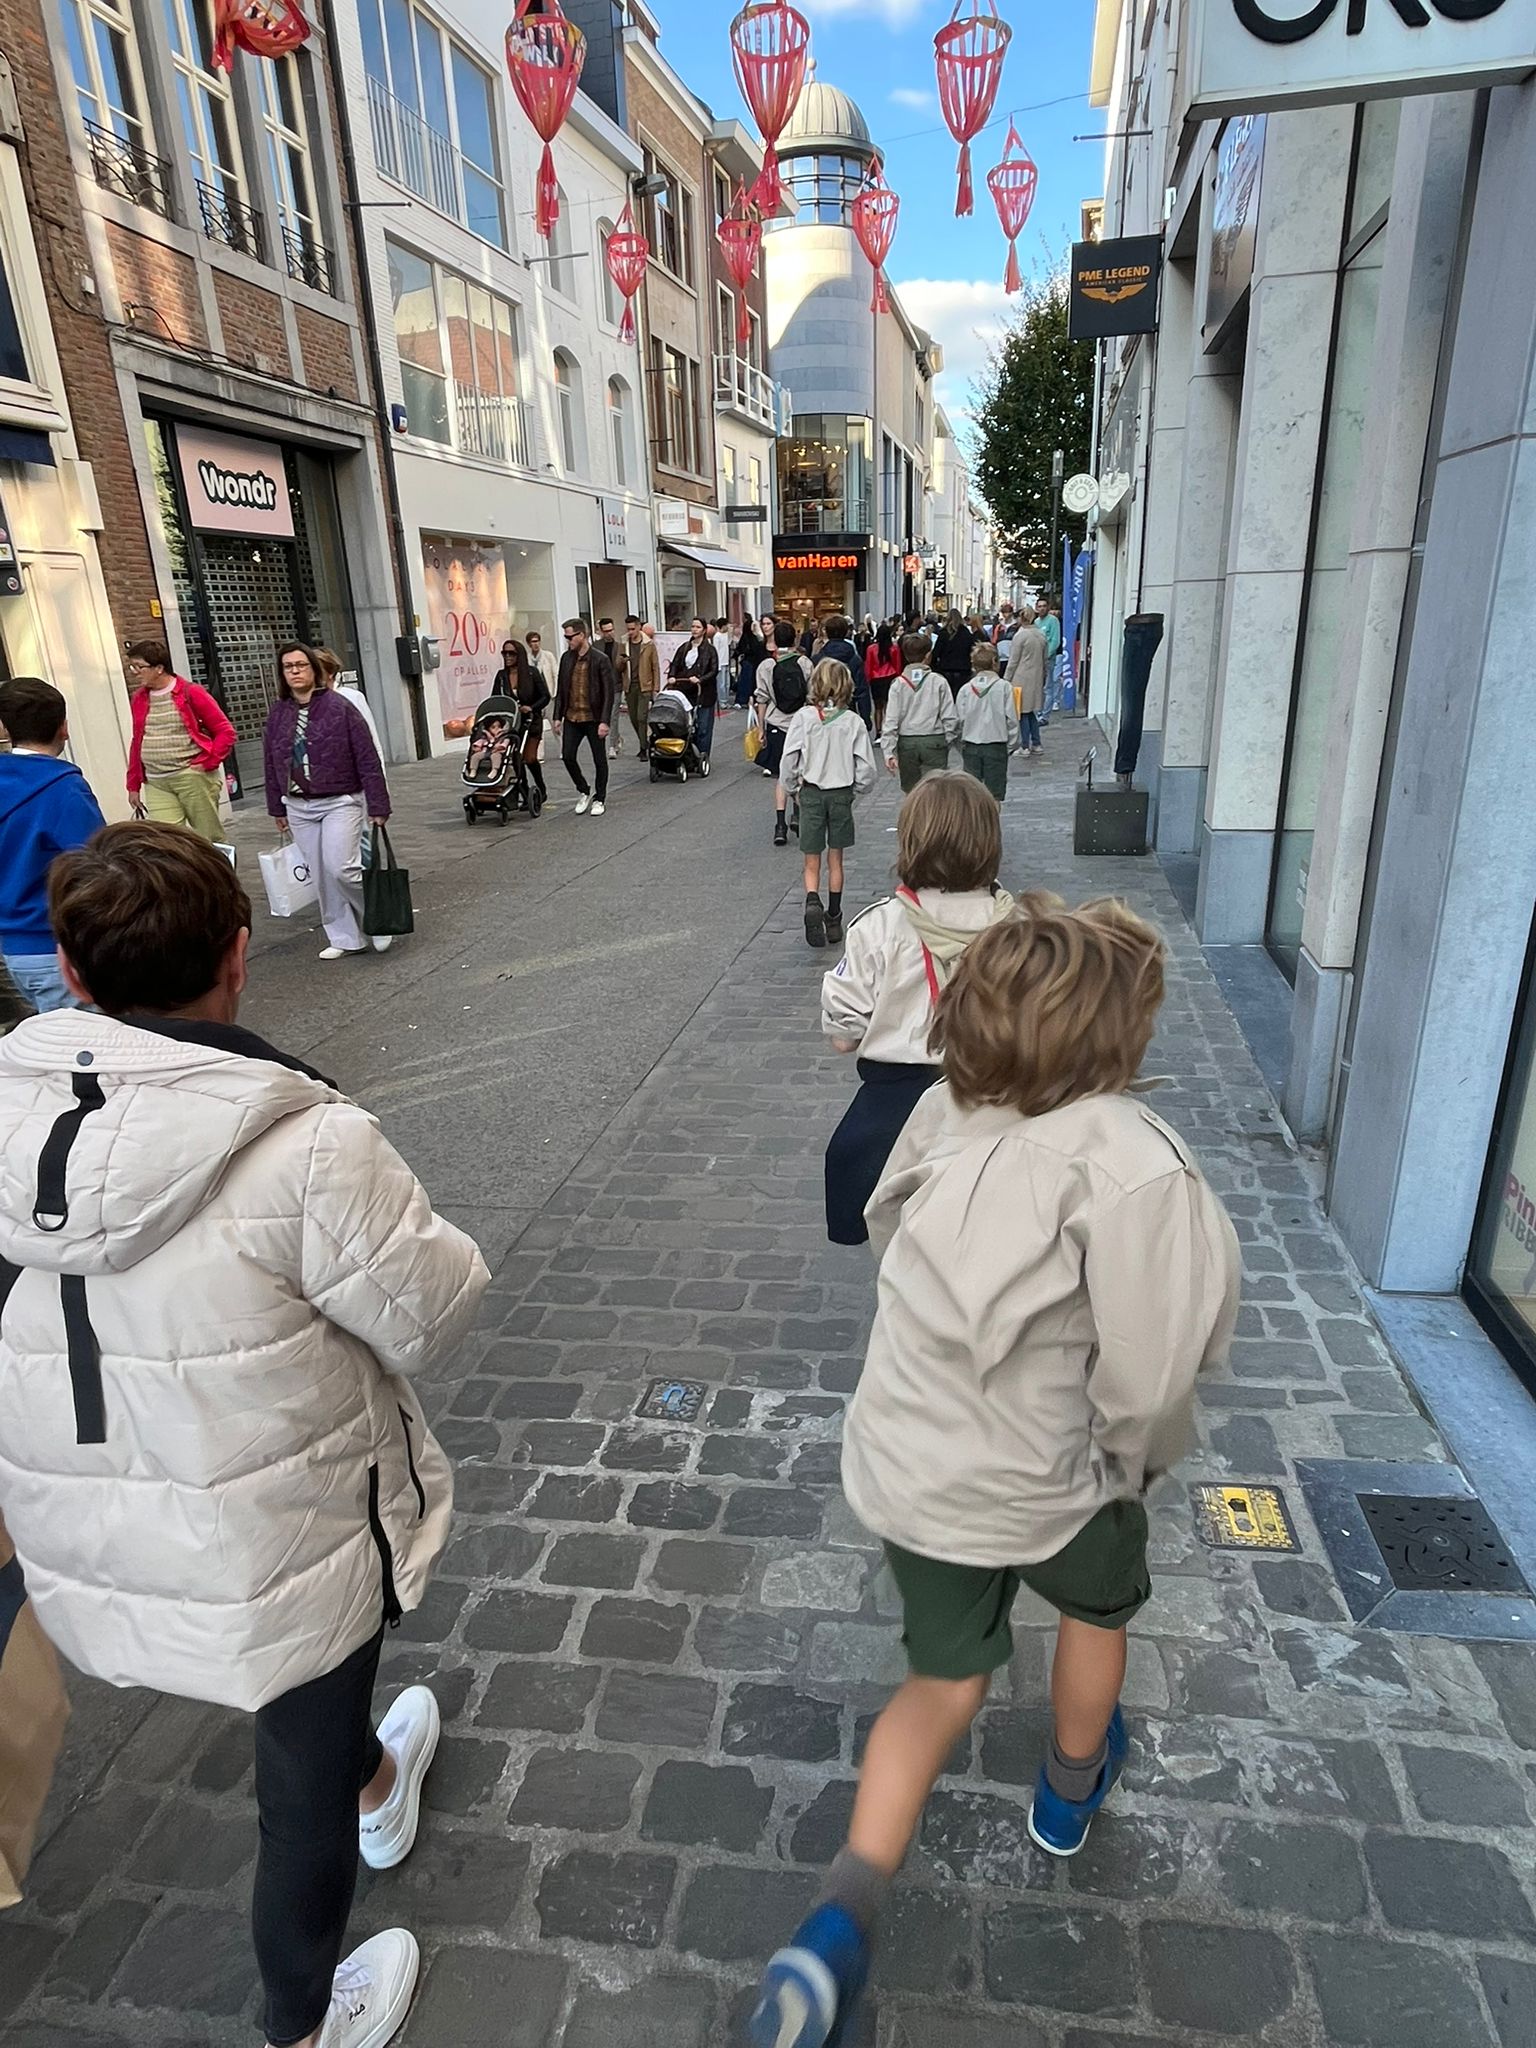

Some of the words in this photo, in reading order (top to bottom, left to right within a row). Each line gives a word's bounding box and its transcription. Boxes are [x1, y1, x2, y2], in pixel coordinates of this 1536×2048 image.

[1078, 269, 1103, 281] PME
[1105, 265, 1150, 279] LEGEND
[200, 464, 275, 506] Wondr
[776, 554, 858, 569] vanHaren
[934, 556, 946, 594] ONLY
[446, 612, 496, 656] 20%
[454, 666, 465, 678] OP
[466, 664, 489, 677] ALLES
[1502, 1170, 1536, 1231] Pin
